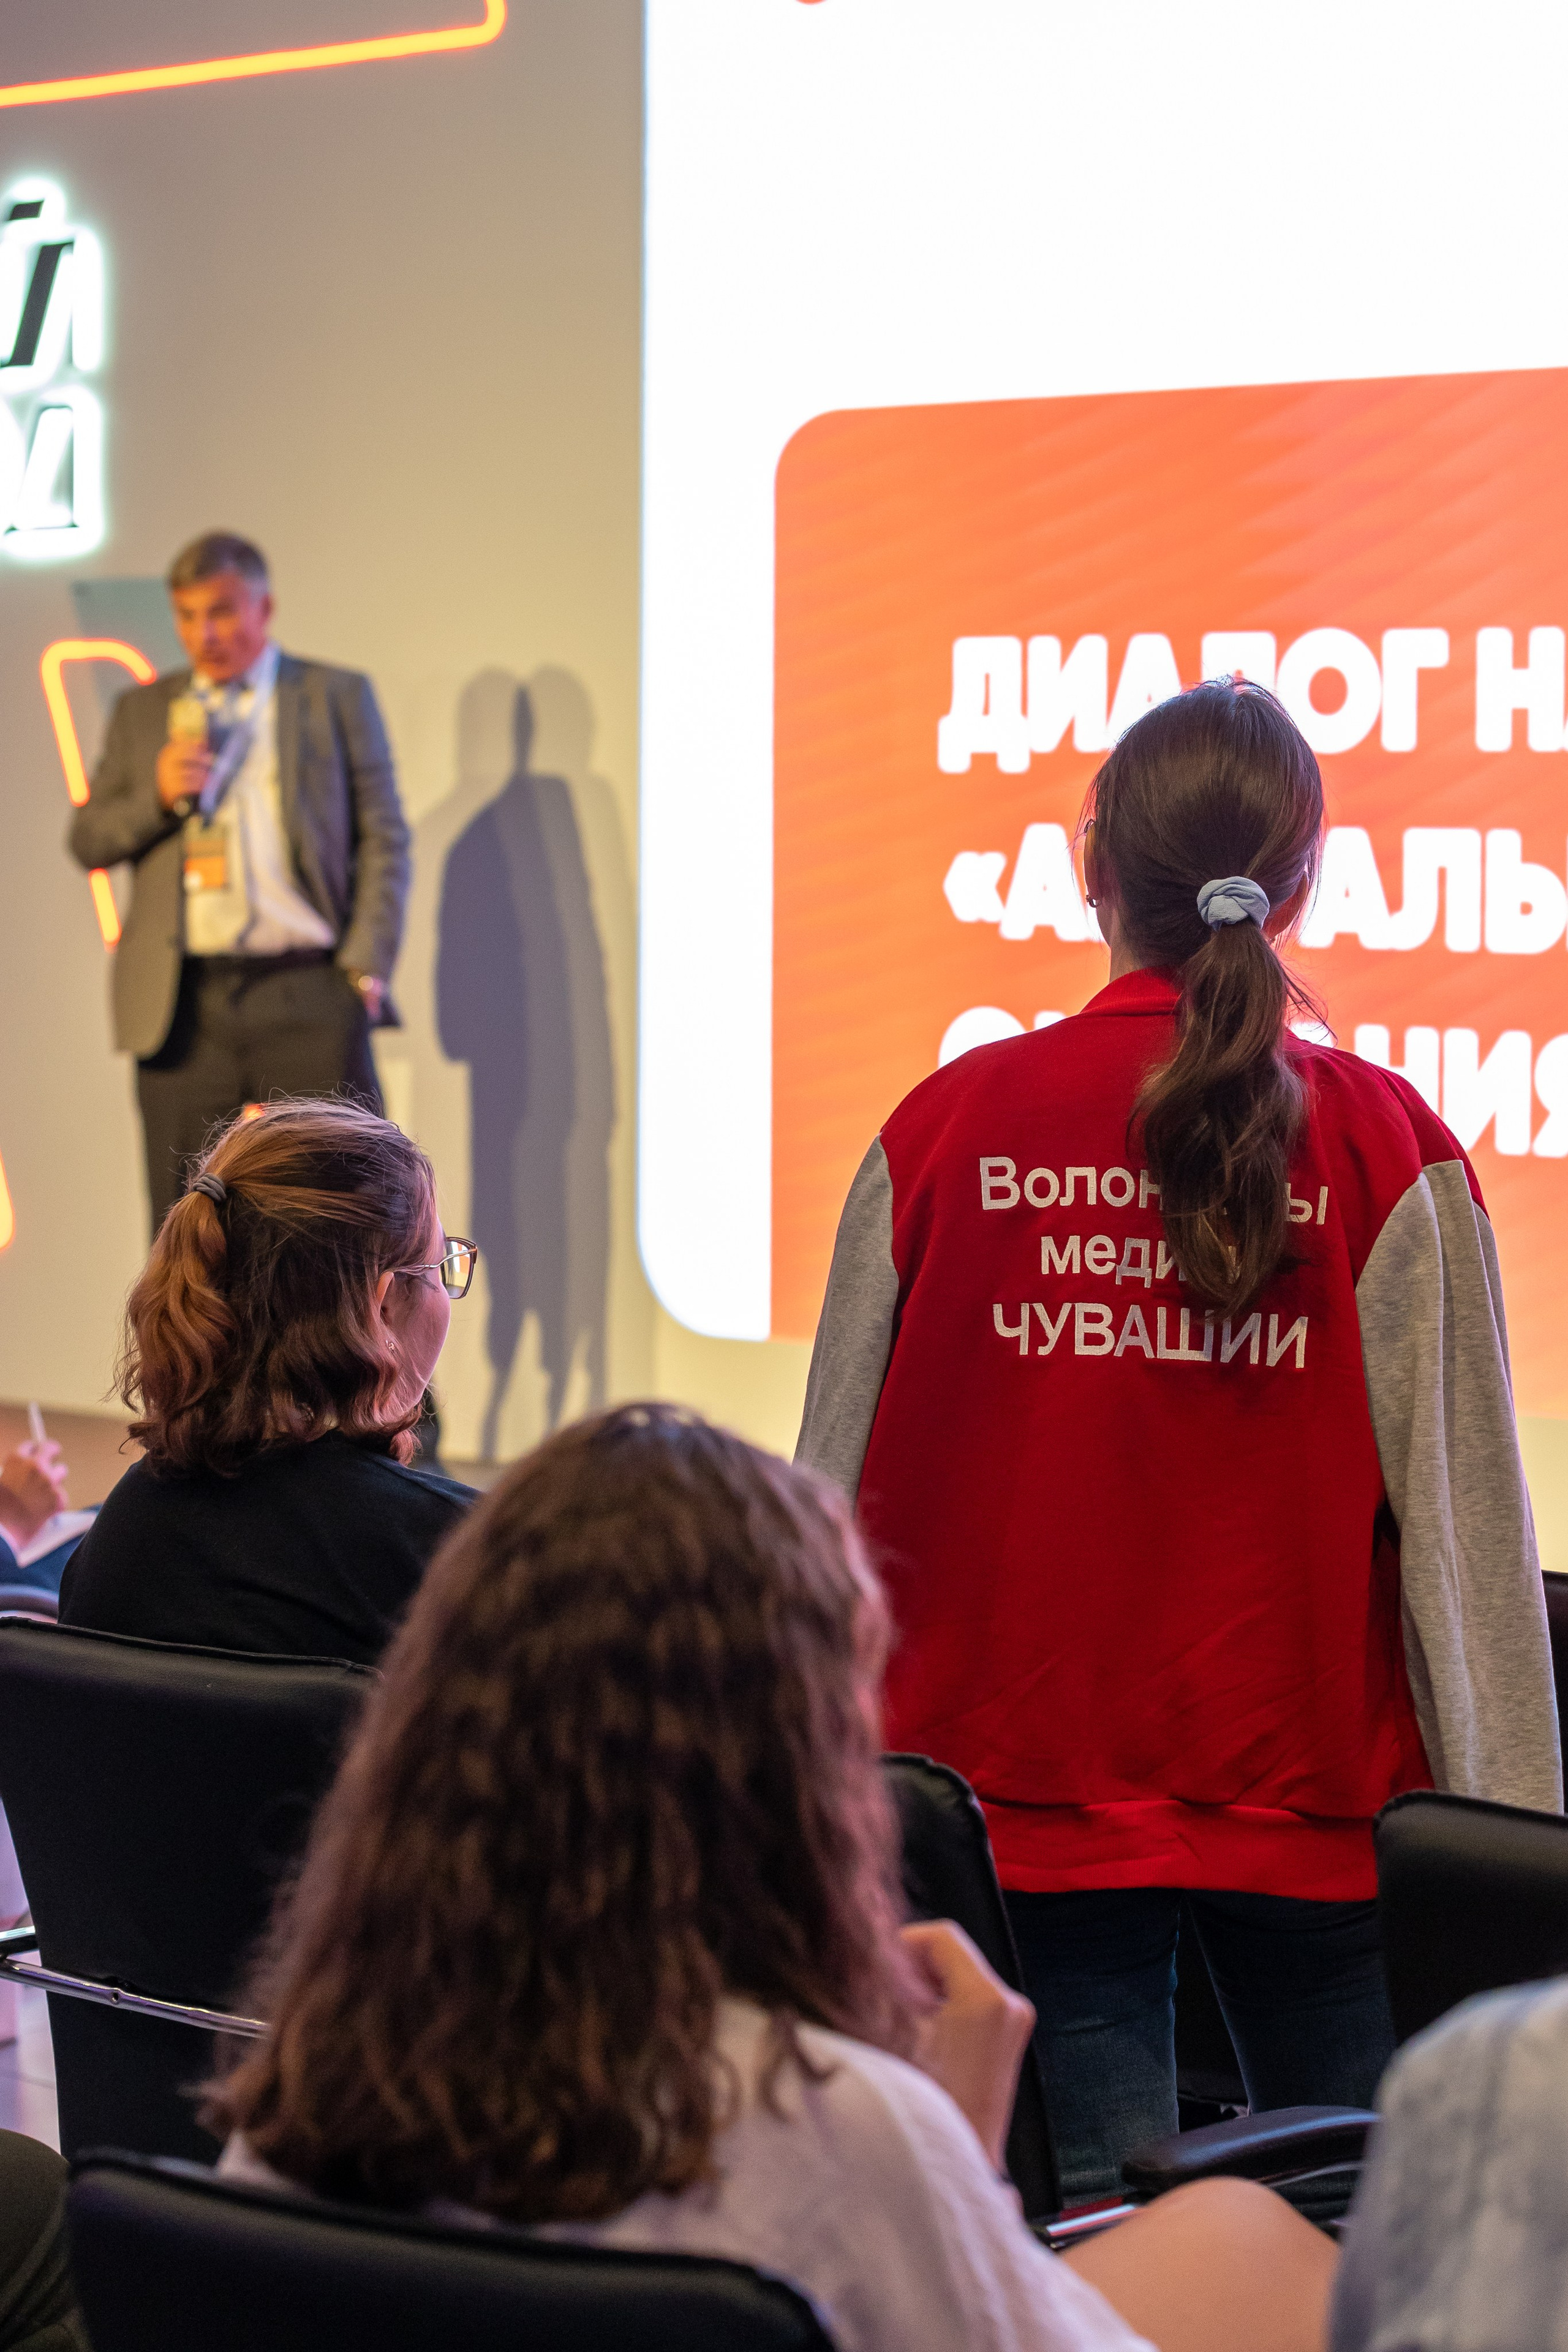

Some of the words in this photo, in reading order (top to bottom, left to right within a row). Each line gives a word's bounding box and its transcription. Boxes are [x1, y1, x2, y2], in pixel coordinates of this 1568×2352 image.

[1476, 625, 1568, 753] Н
[980, 1156, 1328, 1225] Волоны
[993, 1303, 1308, 1369] ЧУВАШИИ
